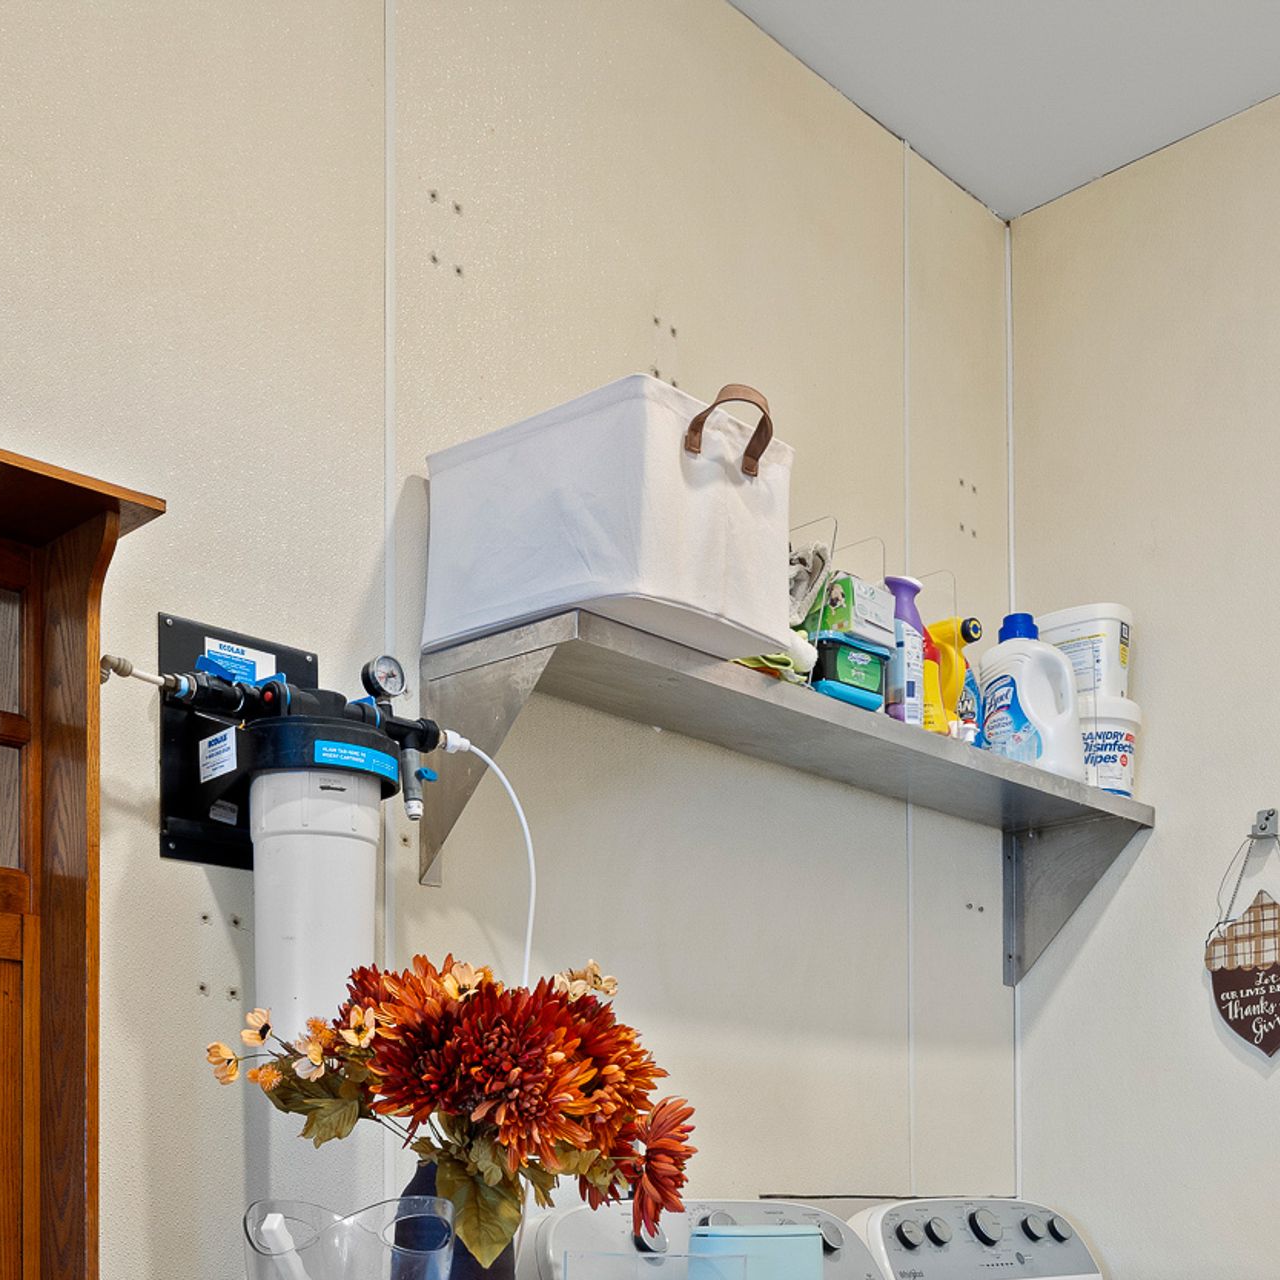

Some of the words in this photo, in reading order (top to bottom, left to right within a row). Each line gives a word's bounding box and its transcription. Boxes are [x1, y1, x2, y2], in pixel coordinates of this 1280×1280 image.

[1220, 990, 1238, 1000] OUR
[1240, 986, 1266, 998] LIVES
[1222, 996, 1277, 1020] Thanks
